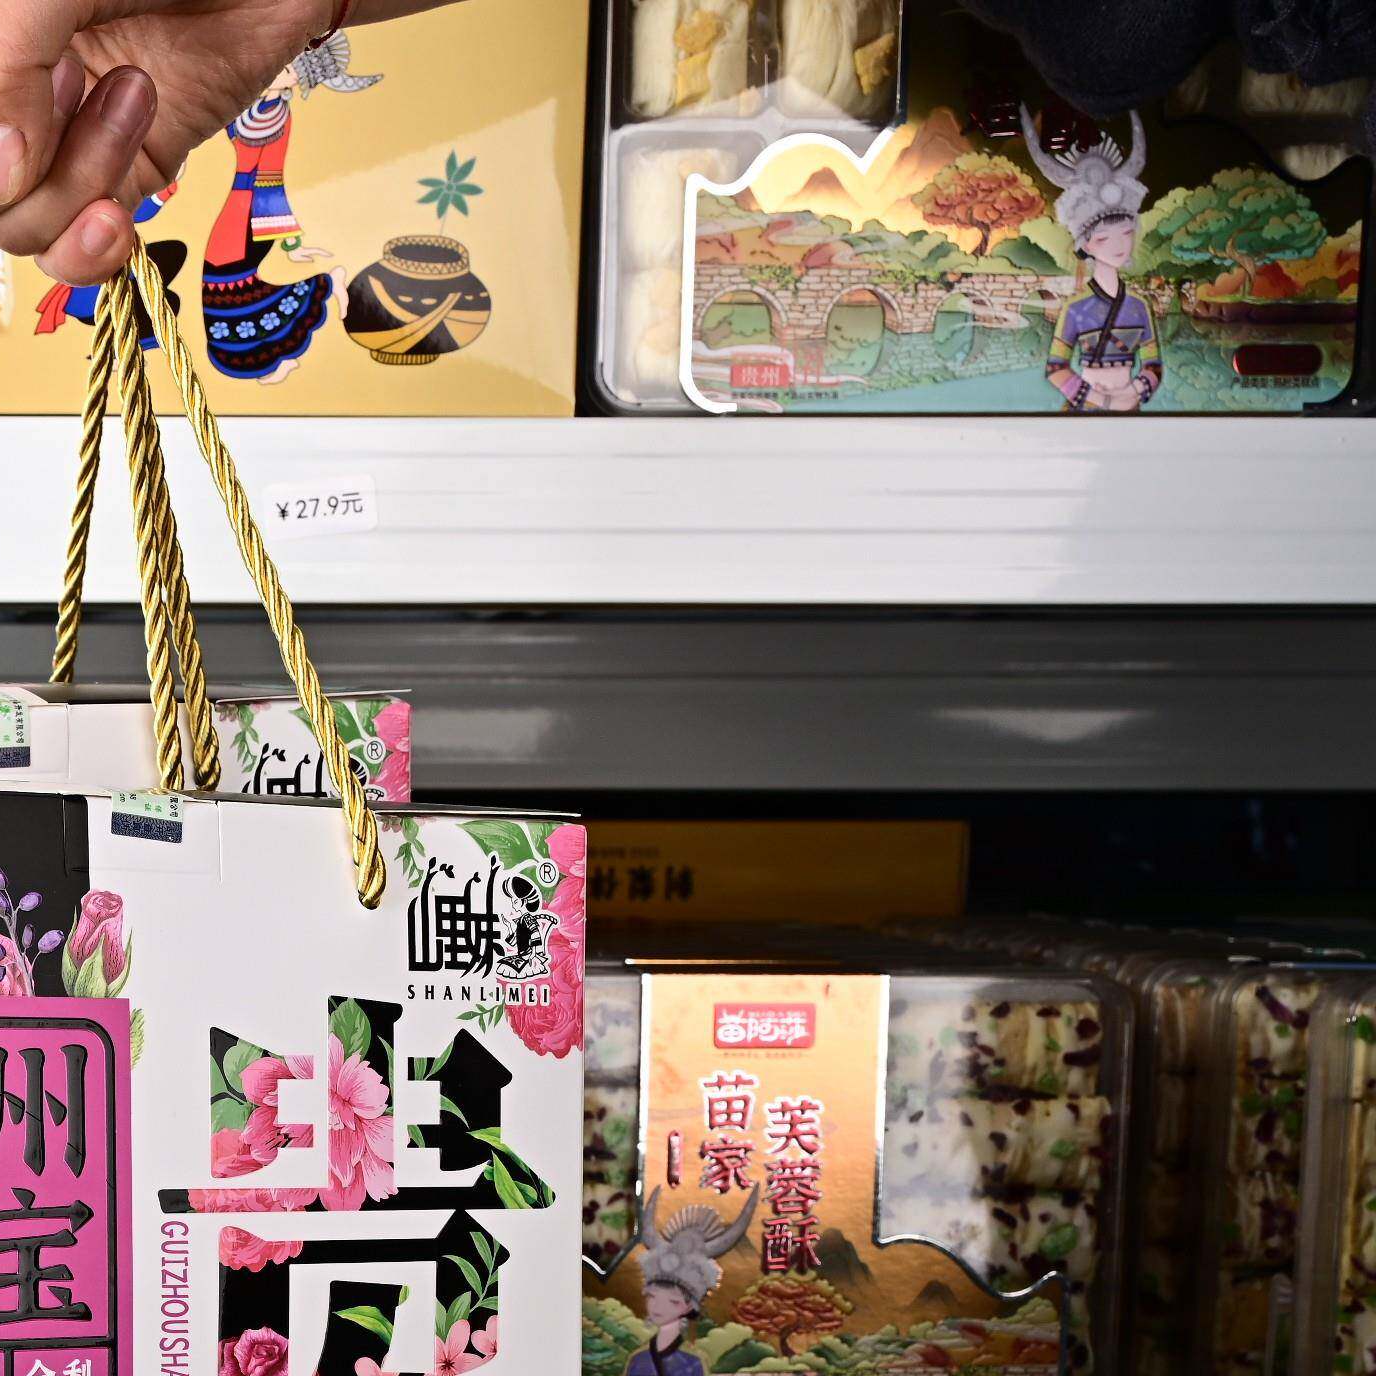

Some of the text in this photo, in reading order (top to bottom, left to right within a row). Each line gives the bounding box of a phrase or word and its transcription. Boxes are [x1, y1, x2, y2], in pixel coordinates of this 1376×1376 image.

[407, 983, 550, 1005] SHANLIMEI
[699, 1070, 759, 1193] 苗家
[762, 1098, 823, 1275] 芙蓉酥
